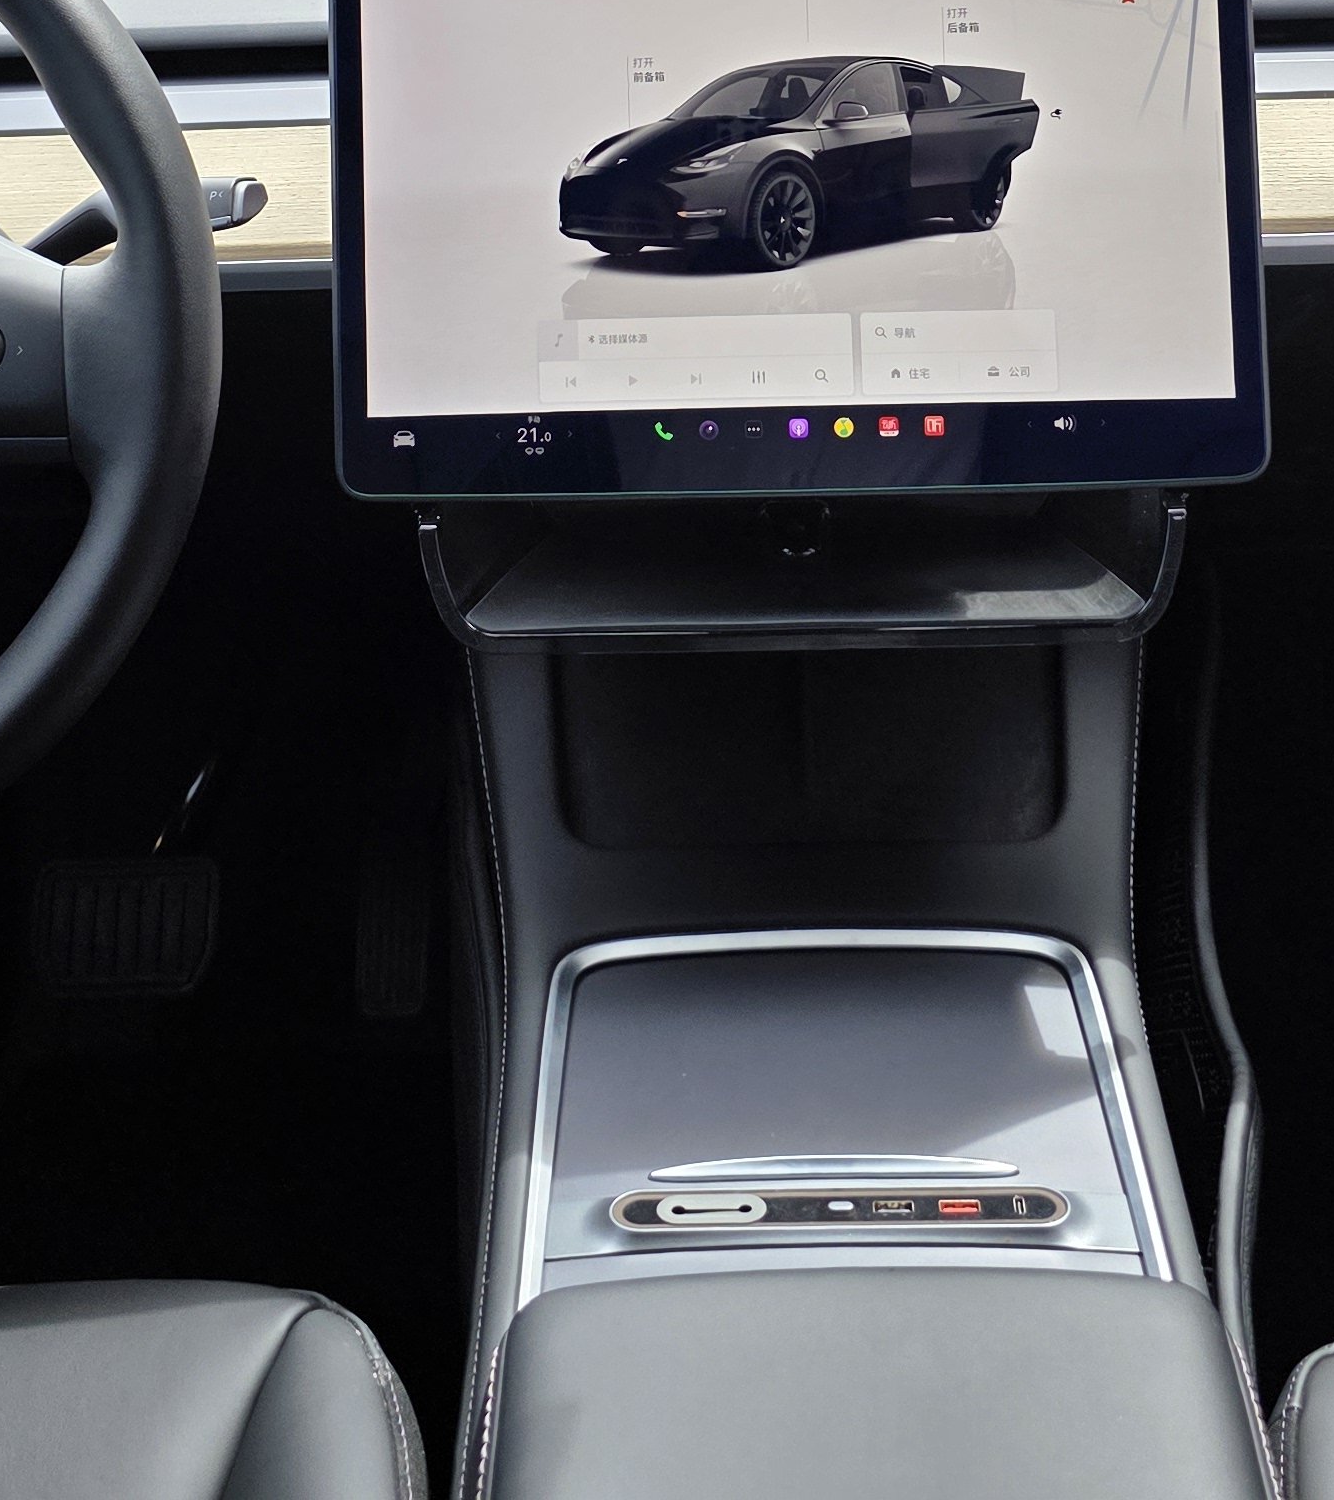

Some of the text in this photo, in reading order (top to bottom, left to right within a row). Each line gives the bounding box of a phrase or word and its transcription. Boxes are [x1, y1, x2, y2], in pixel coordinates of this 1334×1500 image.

[947, 8, 968, 19] 打开
[947, 22, 980, 33] 后备箱
[633, 57, 654, 68] 打开
[633, 71, 665, 83] 前备箱
[598, 333, 649, 345] 选择媒体源
[894, 327, 916, 339] 导航
[909, 367, 931, 379] 住宅
[1009, 366, 1031, 378] 公司
[517, 427, 552, 443] 21.0
